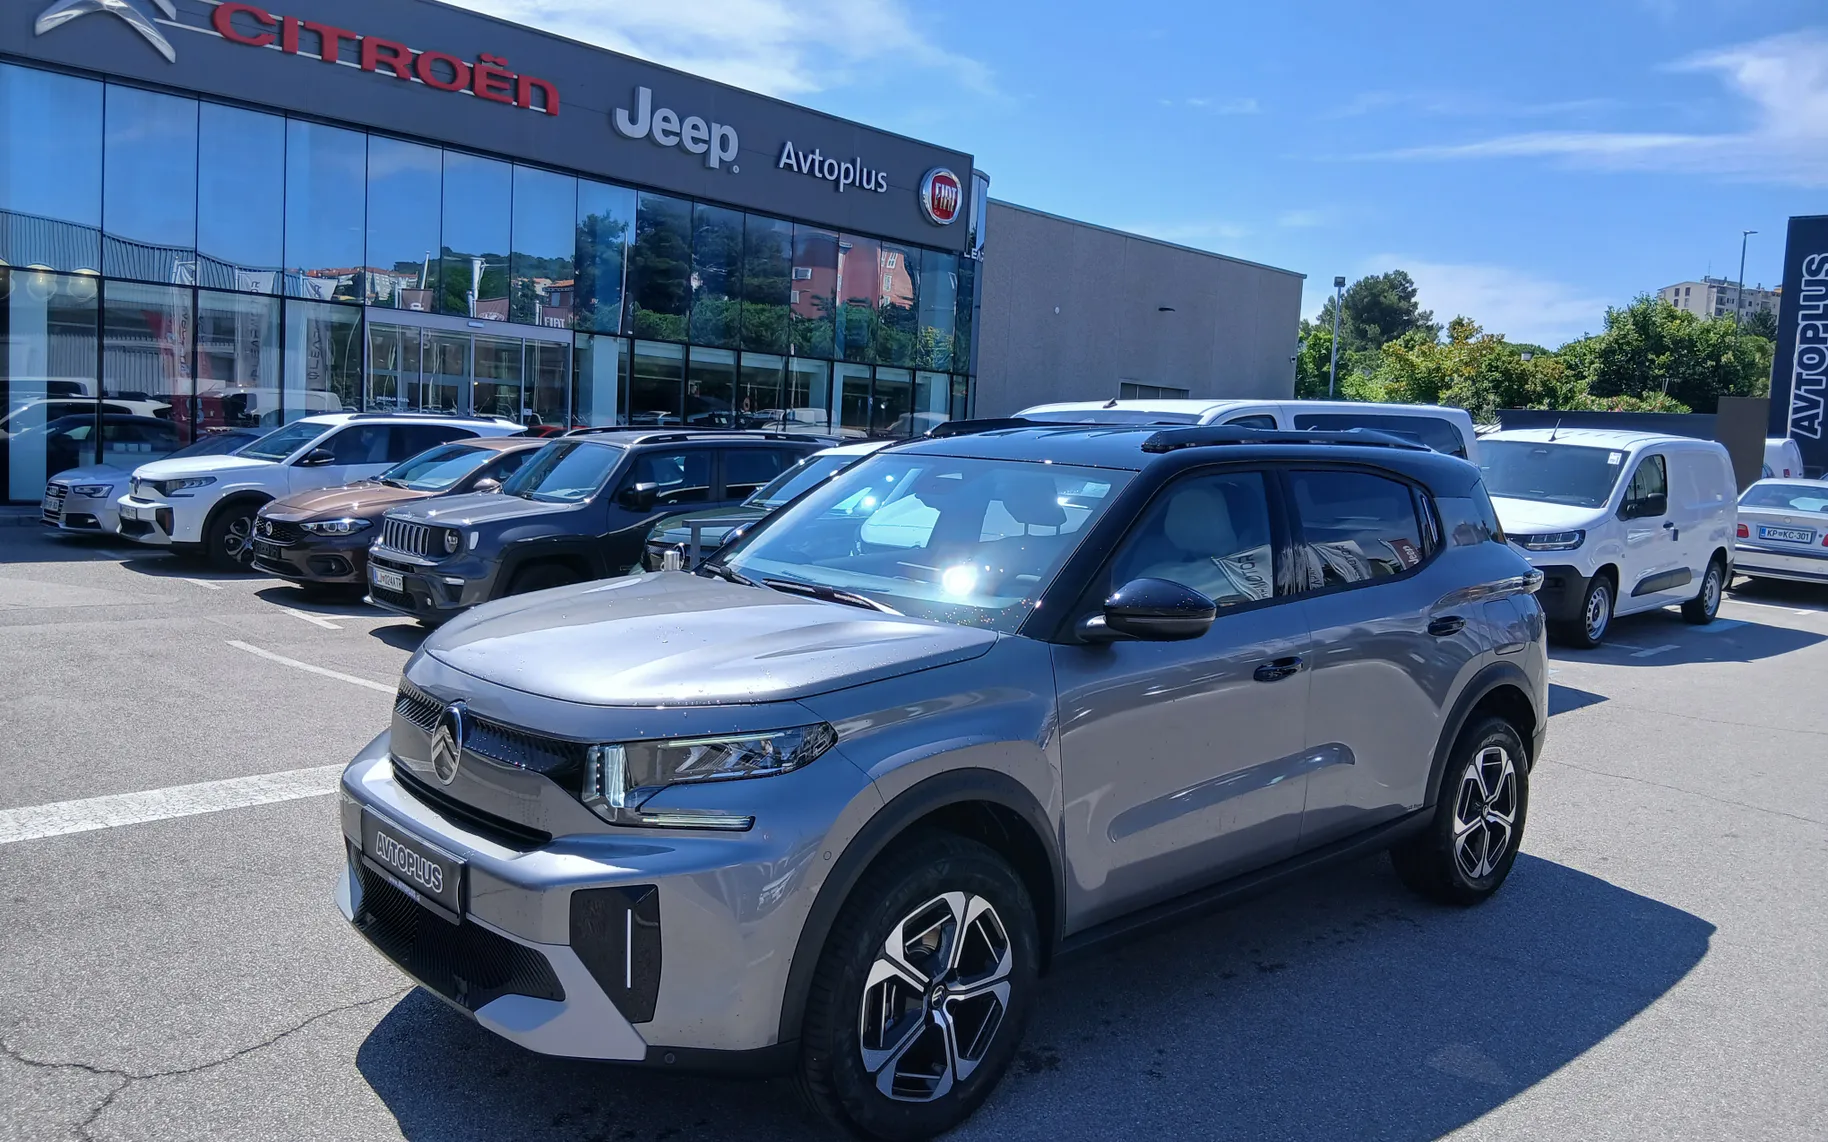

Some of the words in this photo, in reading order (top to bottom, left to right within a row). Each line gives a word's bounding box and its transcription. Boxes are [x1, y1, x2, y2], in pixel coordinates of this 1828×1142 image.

[612, 86, 740, 170] Jeep
[779, 141, 888, 192] Avtoplus
[934, 182, 958, 213] FIAT
[544, 316, 566, 329] FIAT
[1791, 252, 1828, 440] AVTOPLUS
[1402, 545, 1419, 565] Jeep
[376, 831, 443, 893] AVTOPLUS
